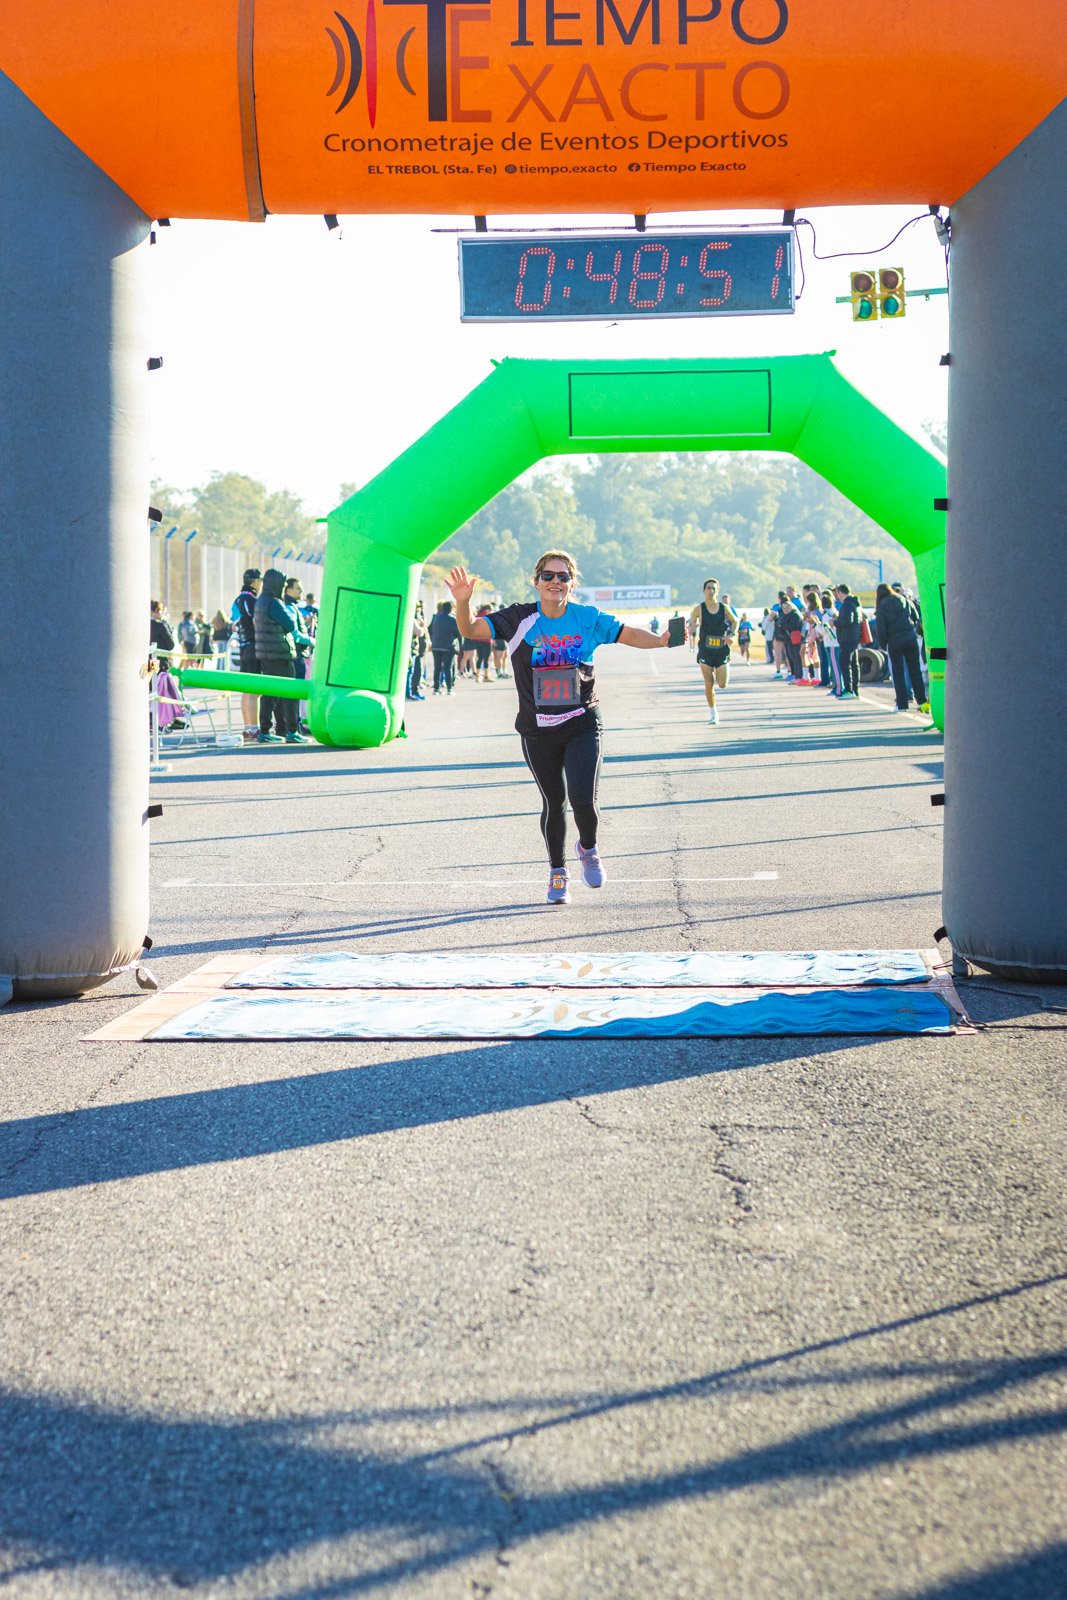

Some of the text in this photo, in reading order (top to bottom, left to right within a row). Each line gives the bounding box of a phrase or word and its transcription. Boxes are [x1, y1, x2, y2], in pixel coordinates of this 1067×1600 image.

[323, 130, 789, 156] Cronometraje de Eventos Deportivos
[368, 161, 747, 175] EL TREBOL (Sta. Fe) tiempo.exacto Tiempo Exacto
[616, 590, 662, 599] LONG
[542, 679, 570, 699] 271
